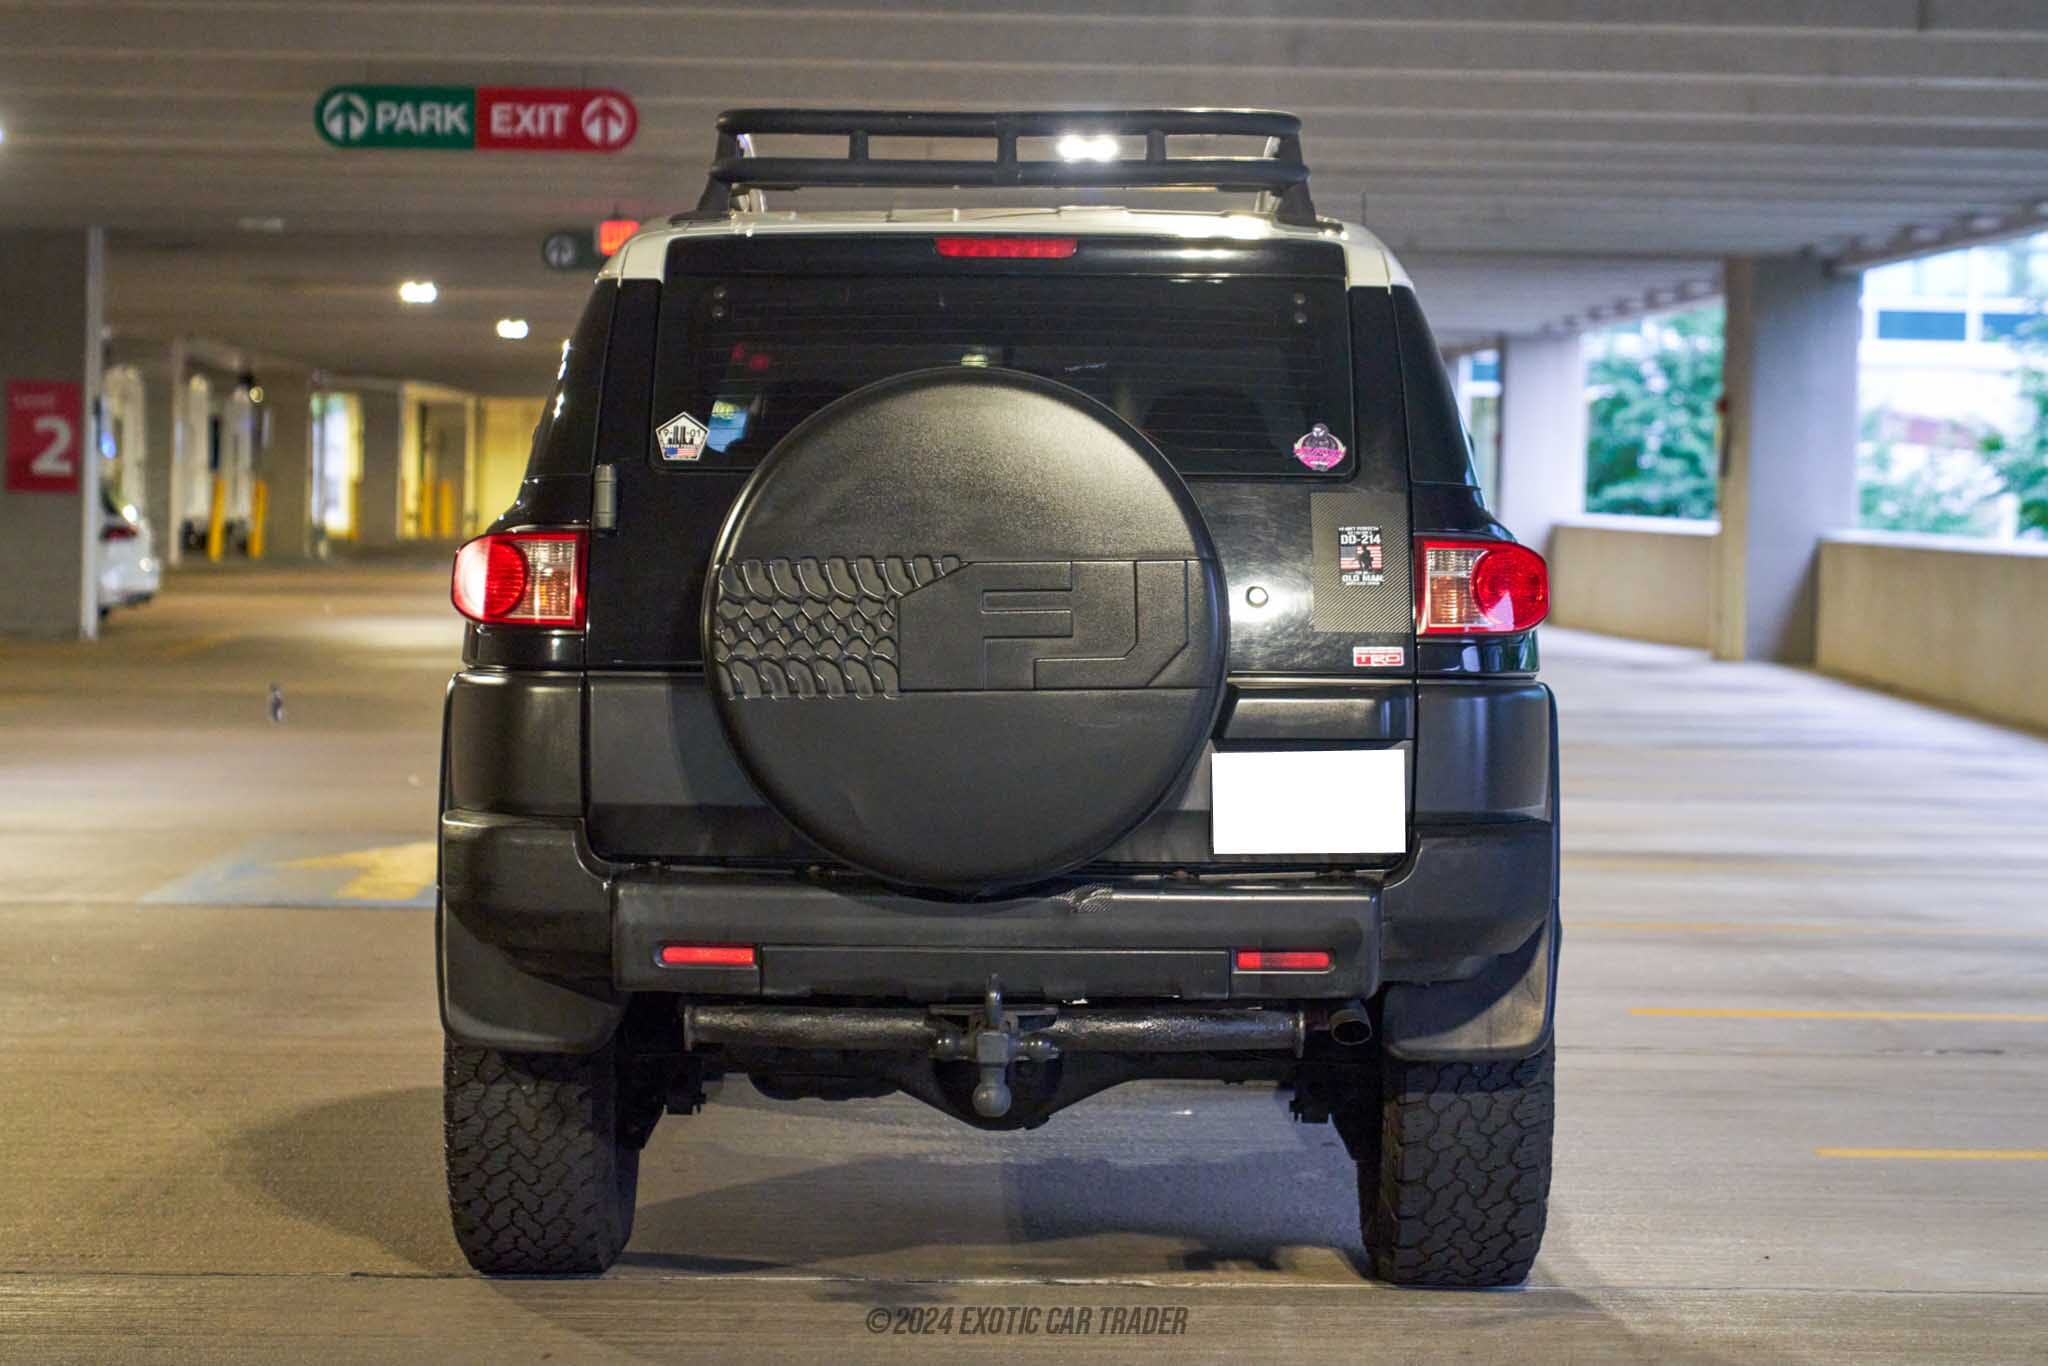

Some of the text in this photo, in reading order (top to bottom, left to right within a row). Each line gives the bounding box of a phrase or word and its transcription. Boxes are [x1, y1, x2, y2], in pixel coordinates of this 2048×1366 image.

[374, 102, 468, 136] PARK
[489, 103, 569, 136] EXIT
[30, 415, 72, 476] 2
[1340, 534, 1381, 545] DD-214
